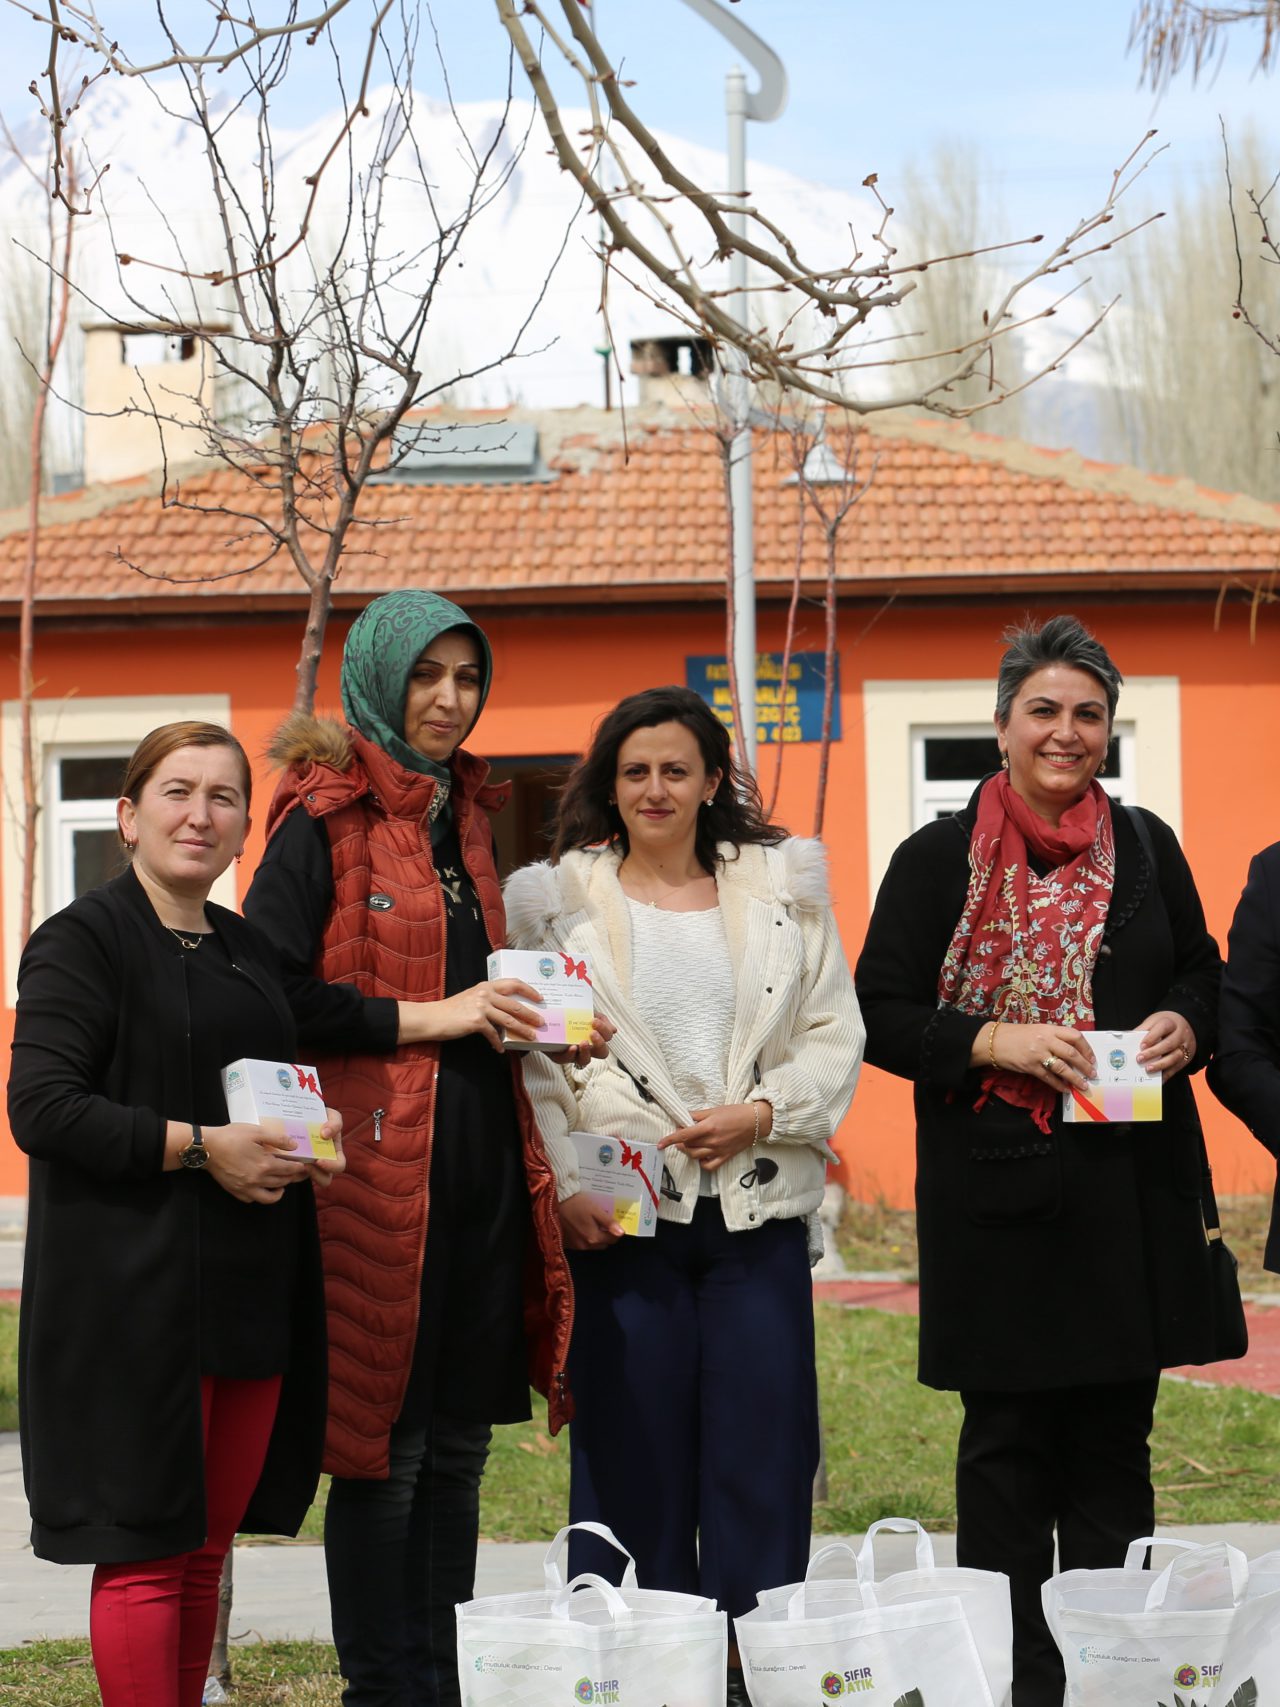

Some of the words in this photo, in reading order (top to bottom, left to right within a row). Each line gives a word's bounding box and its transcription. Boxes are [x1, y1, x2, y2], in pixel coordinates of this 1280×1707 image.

[843, 1667, 872, 1683] SIFIR
[593, 1679, 620, 1692] SIFIR
[847, 1678, 875, 1694] ATIK
[594, 1691, 621, 1705] ATIK
